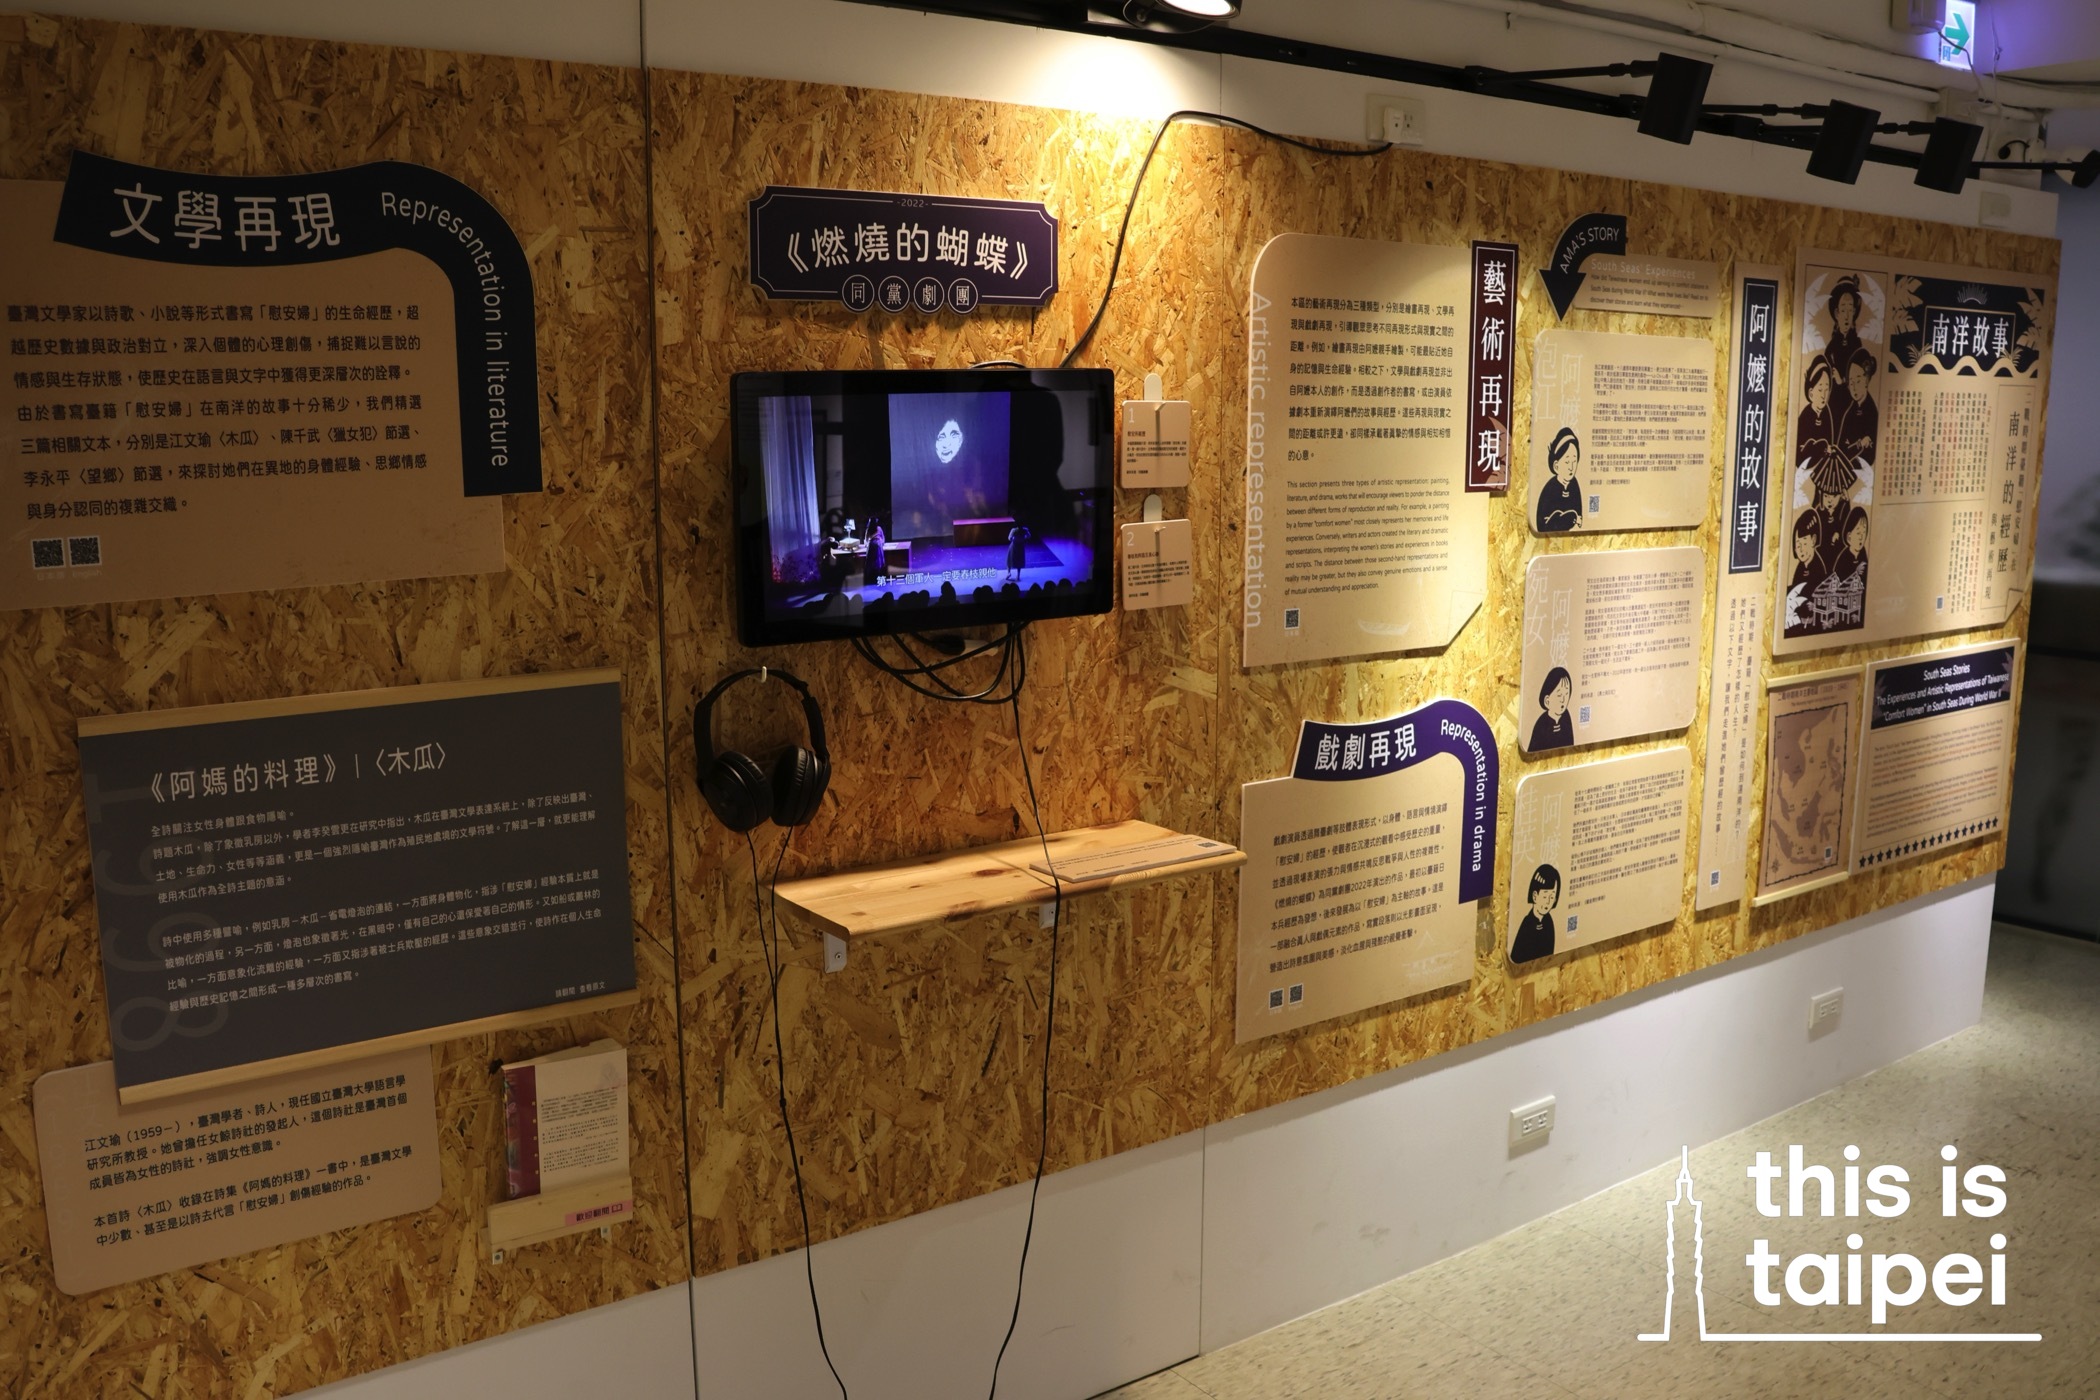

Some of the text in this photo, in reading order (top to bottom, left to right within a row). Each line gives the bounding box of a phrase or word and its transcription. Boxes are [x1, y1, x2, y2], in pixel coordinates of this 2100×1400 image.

[109, 182, 341, 252] 文學再現
[1588, 227, 1620, 242] STORY
[788, 222, 1028, 280] 《燃燒的蝴蝶》
[1591, 258, 1616, 272] South
[1645, 263, 1695, 280] Experiences
[851, 282, 970, 306] 同黨劇團
[381, 192, 510, 467] Representation in literature
[1931, 313, 2010, 358] 南洋故事
[1477, 260, 1506, 472] 藝術再現
[1737, 304, 1770, 544] 阿嬤的故事
[1246, 292, 1272, 629] Artistic representation
[1997, 411, 2020, 573] 南洋的經歷
[1876, 694, 1886, 704] The
[1887, 689, 1915, 705] Experiences
[1917, 687, 1925, 696] and
[1927, 684, 1942, 694] Artistic
[1944, 677, 1978, 693] Representations
[1988, 671, 2008, 682] Taiwanese
[1923, 661, 1970, 678] South Seas Stories
[1932, 699, 1946, 710] South
[1946, 697, 1958, 707] Seas
[1958, 694, 1974, 707] During
[1974, 692, 1988, 701] World
[1988, 690, 1997, 698] War
[1315, 724, 1416, 772] 戲劇再現
[1441, 718, 1488, 872] Representation in drama
[576, 1206, 610, 1222] 歡迎翻閱
